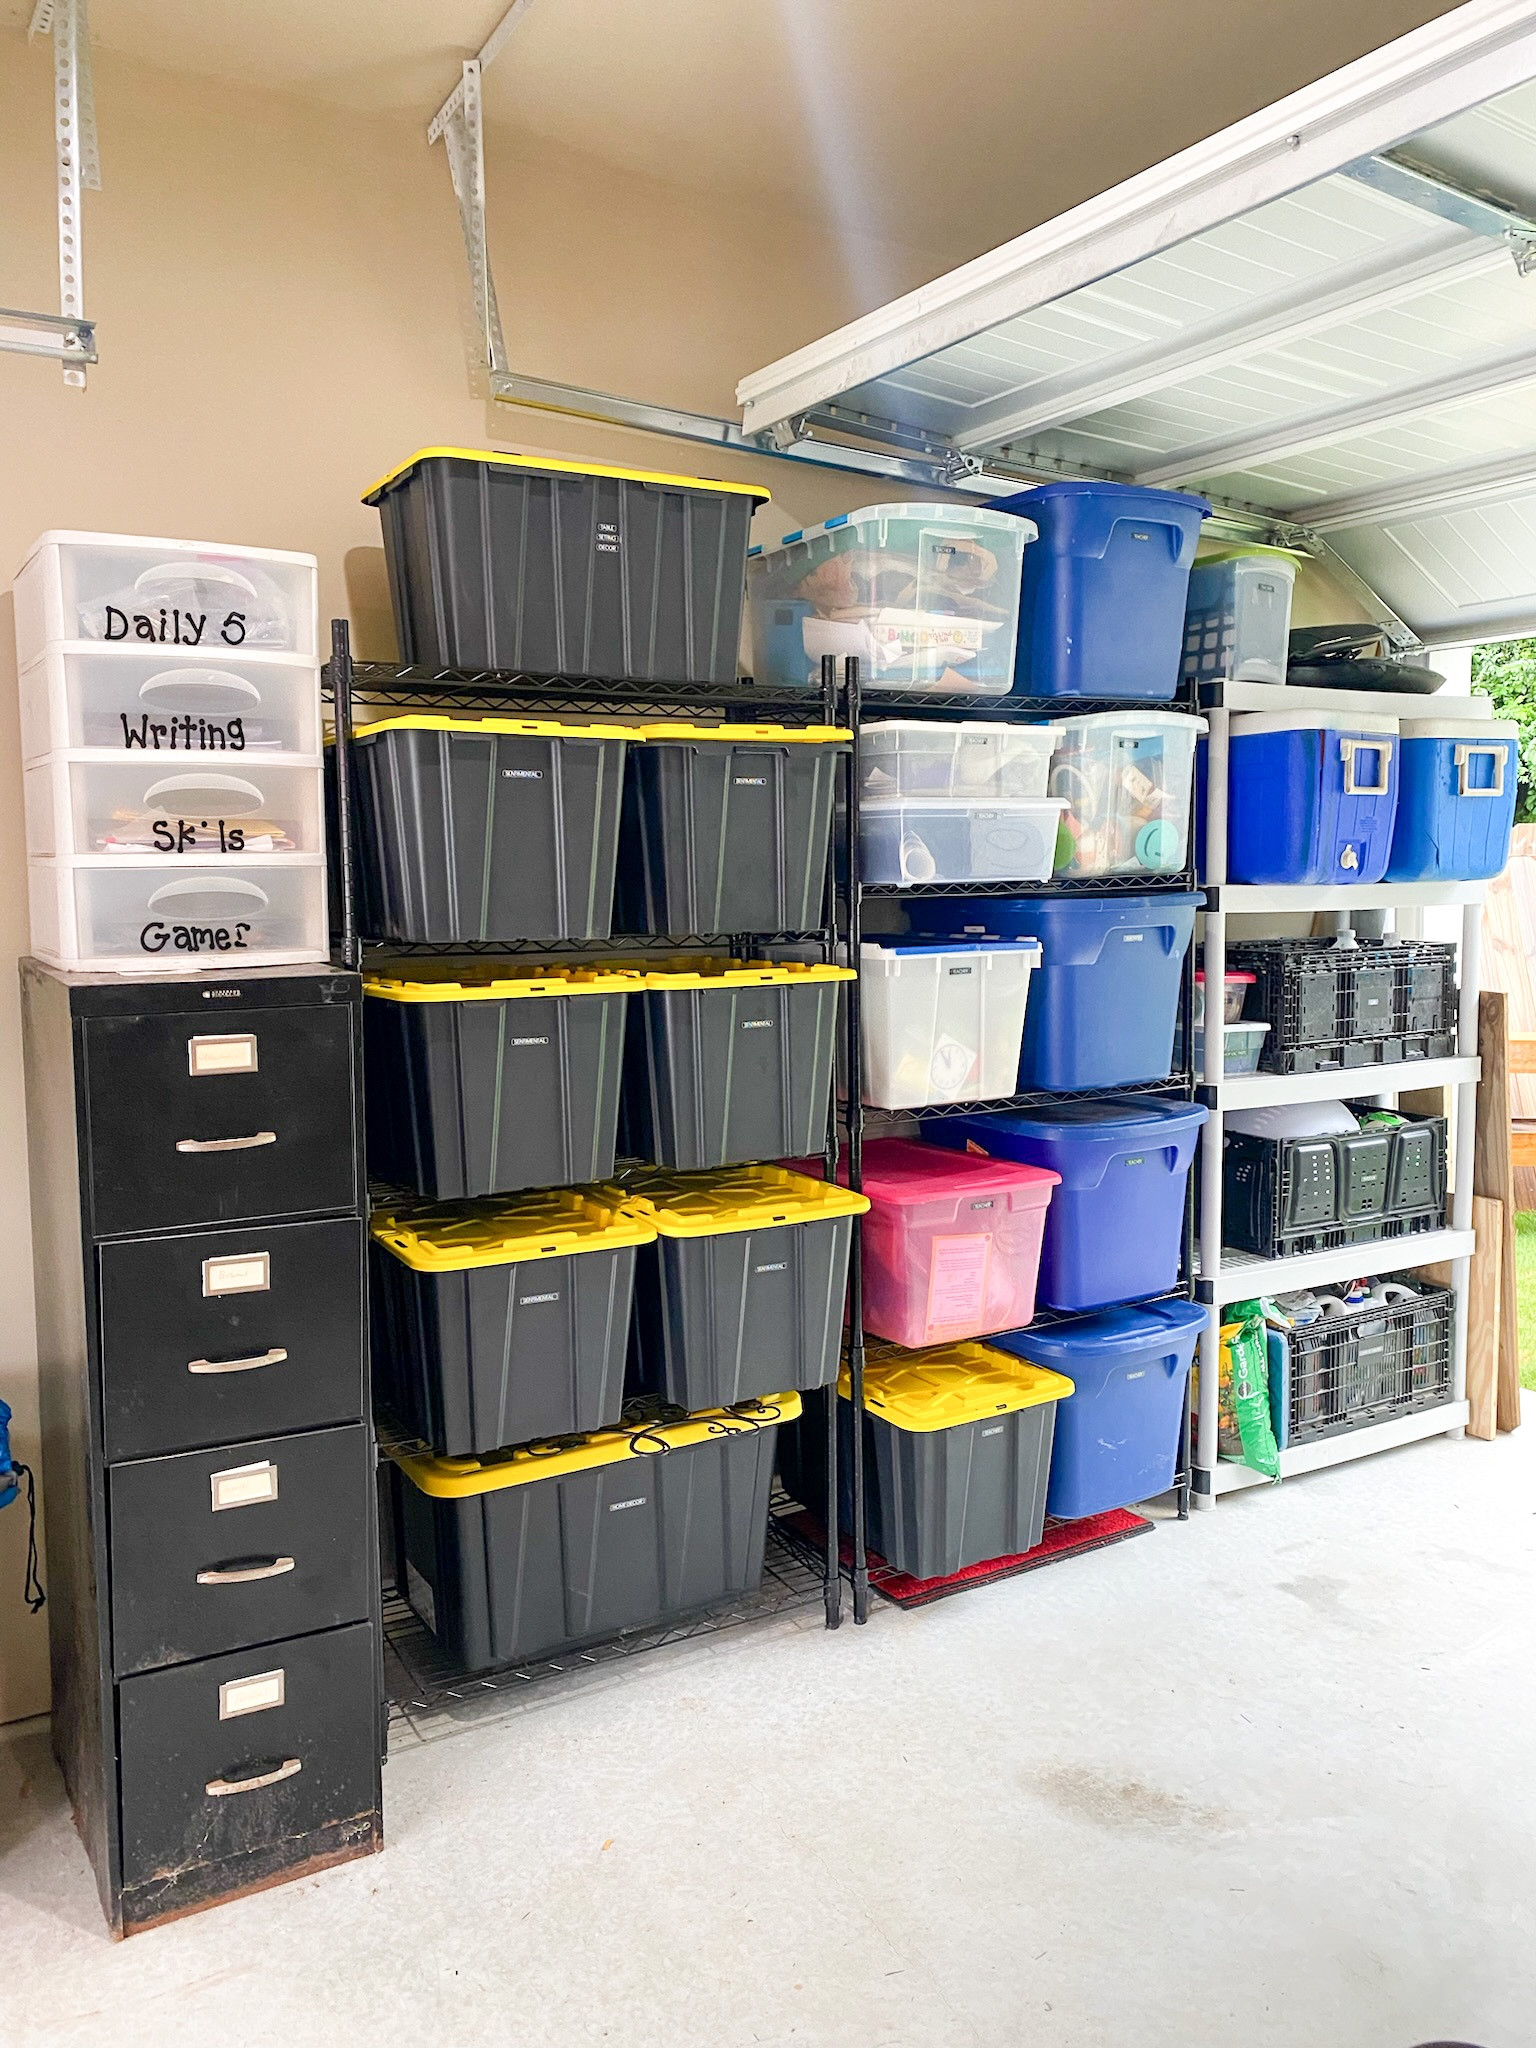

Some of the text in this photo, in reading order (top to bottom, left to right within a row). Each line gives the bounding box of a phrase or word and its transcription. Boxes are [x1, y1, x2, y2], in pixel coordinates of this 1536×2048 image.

[104, 605, 246, 646] Daily 5
[120, 713, 246, 750] Writing
